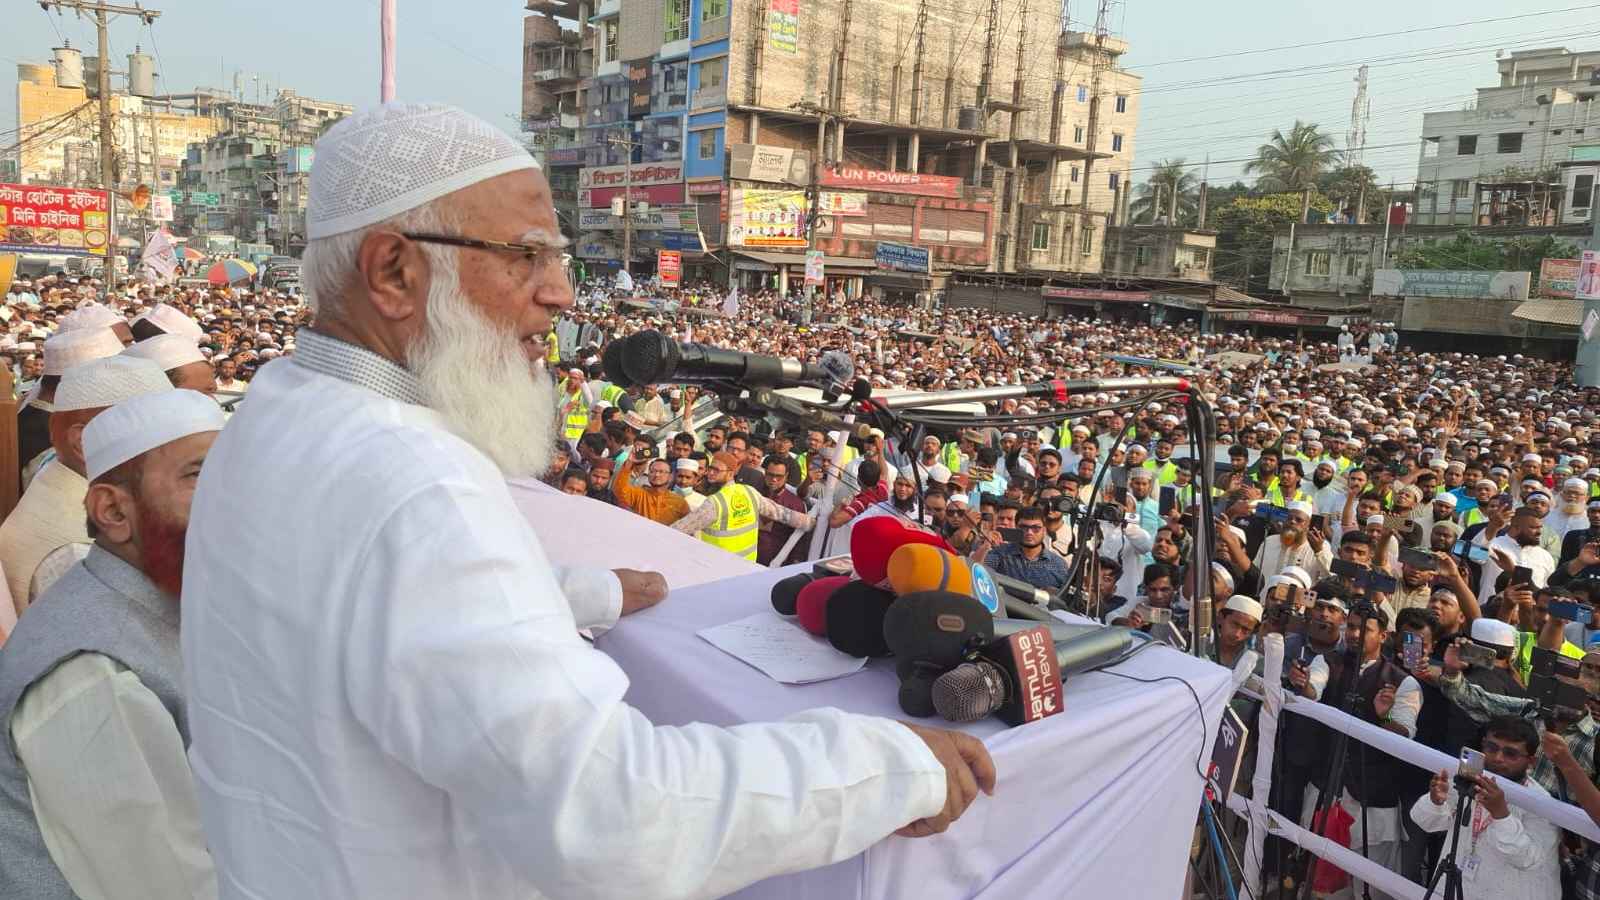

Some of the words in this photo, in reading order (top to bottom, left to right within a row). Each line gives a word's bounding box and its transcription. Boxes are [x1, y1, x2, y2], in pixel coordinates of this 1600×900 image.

[867, 170, 920, 184] POWER
[27, 189, 64, 206] হোটেল
[13, 207, 36, 223] মিনি
[38, 208, 80, 226] চাইনিজ
[1031, 631, 1053, 688] news
